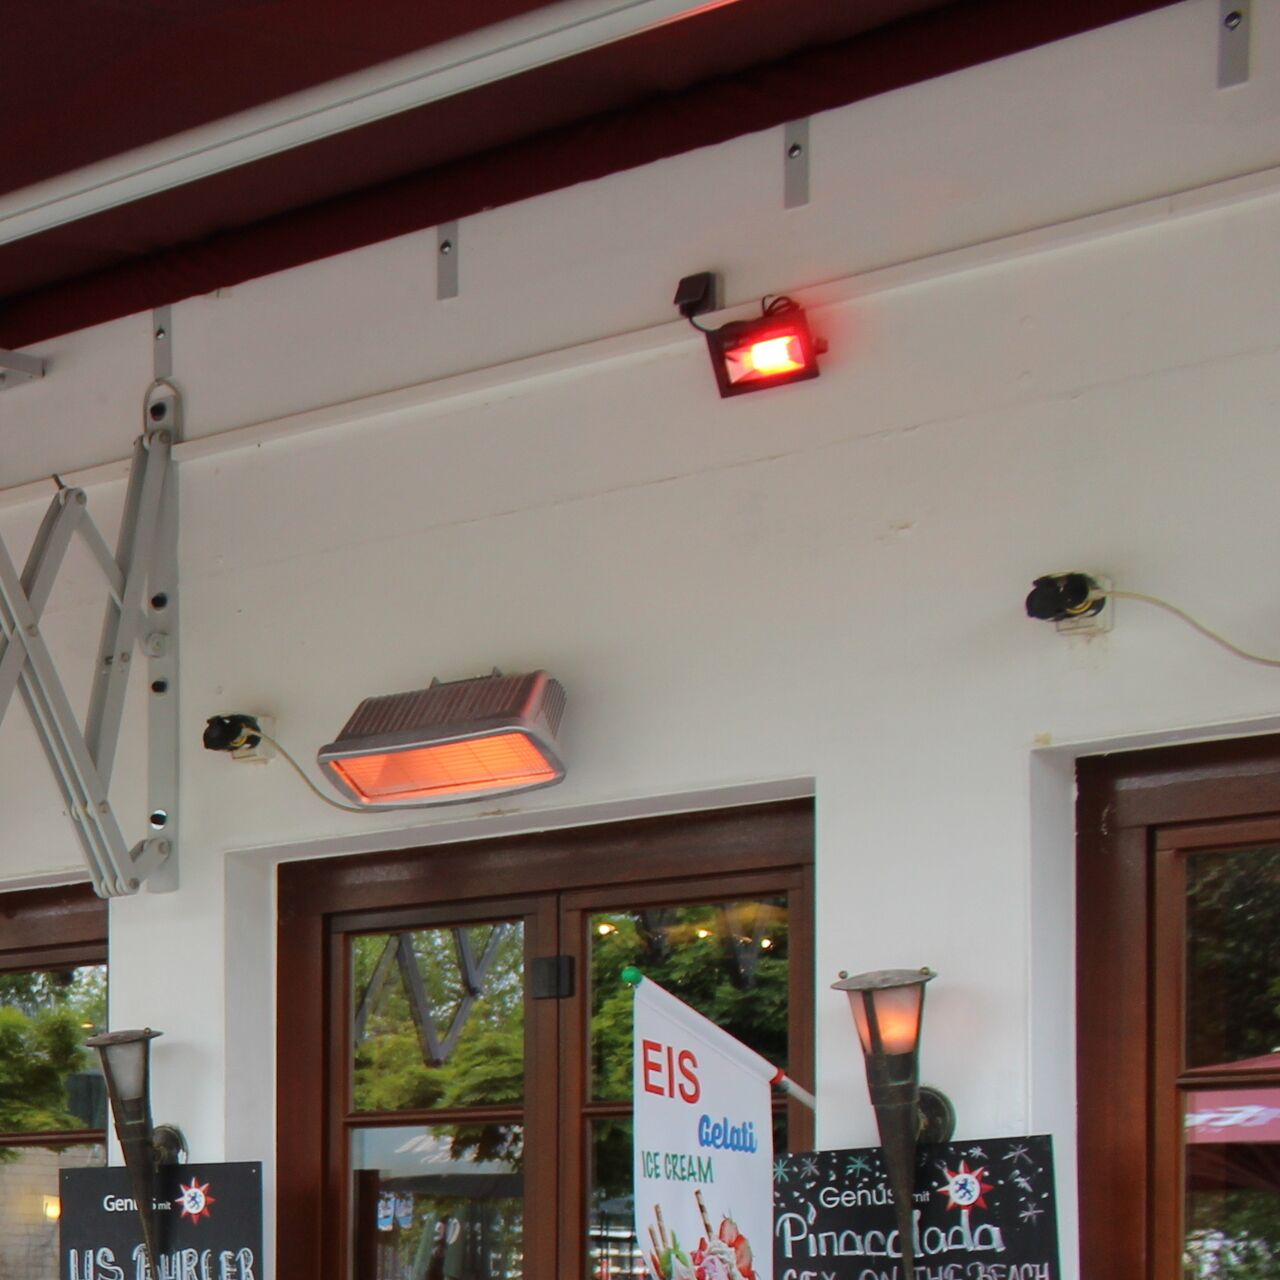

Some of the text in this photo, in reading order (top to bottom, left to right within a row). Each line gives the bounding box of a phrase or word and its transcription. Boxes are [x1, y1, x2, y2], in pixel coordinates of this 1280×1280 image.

[642, 1038, 701, 1104] EIS
[697, 1113, 758, 1154] Gelati
[641, 1150, 715, 1184] ICE CREAM
[158, 1202, 172, 1211] mit
